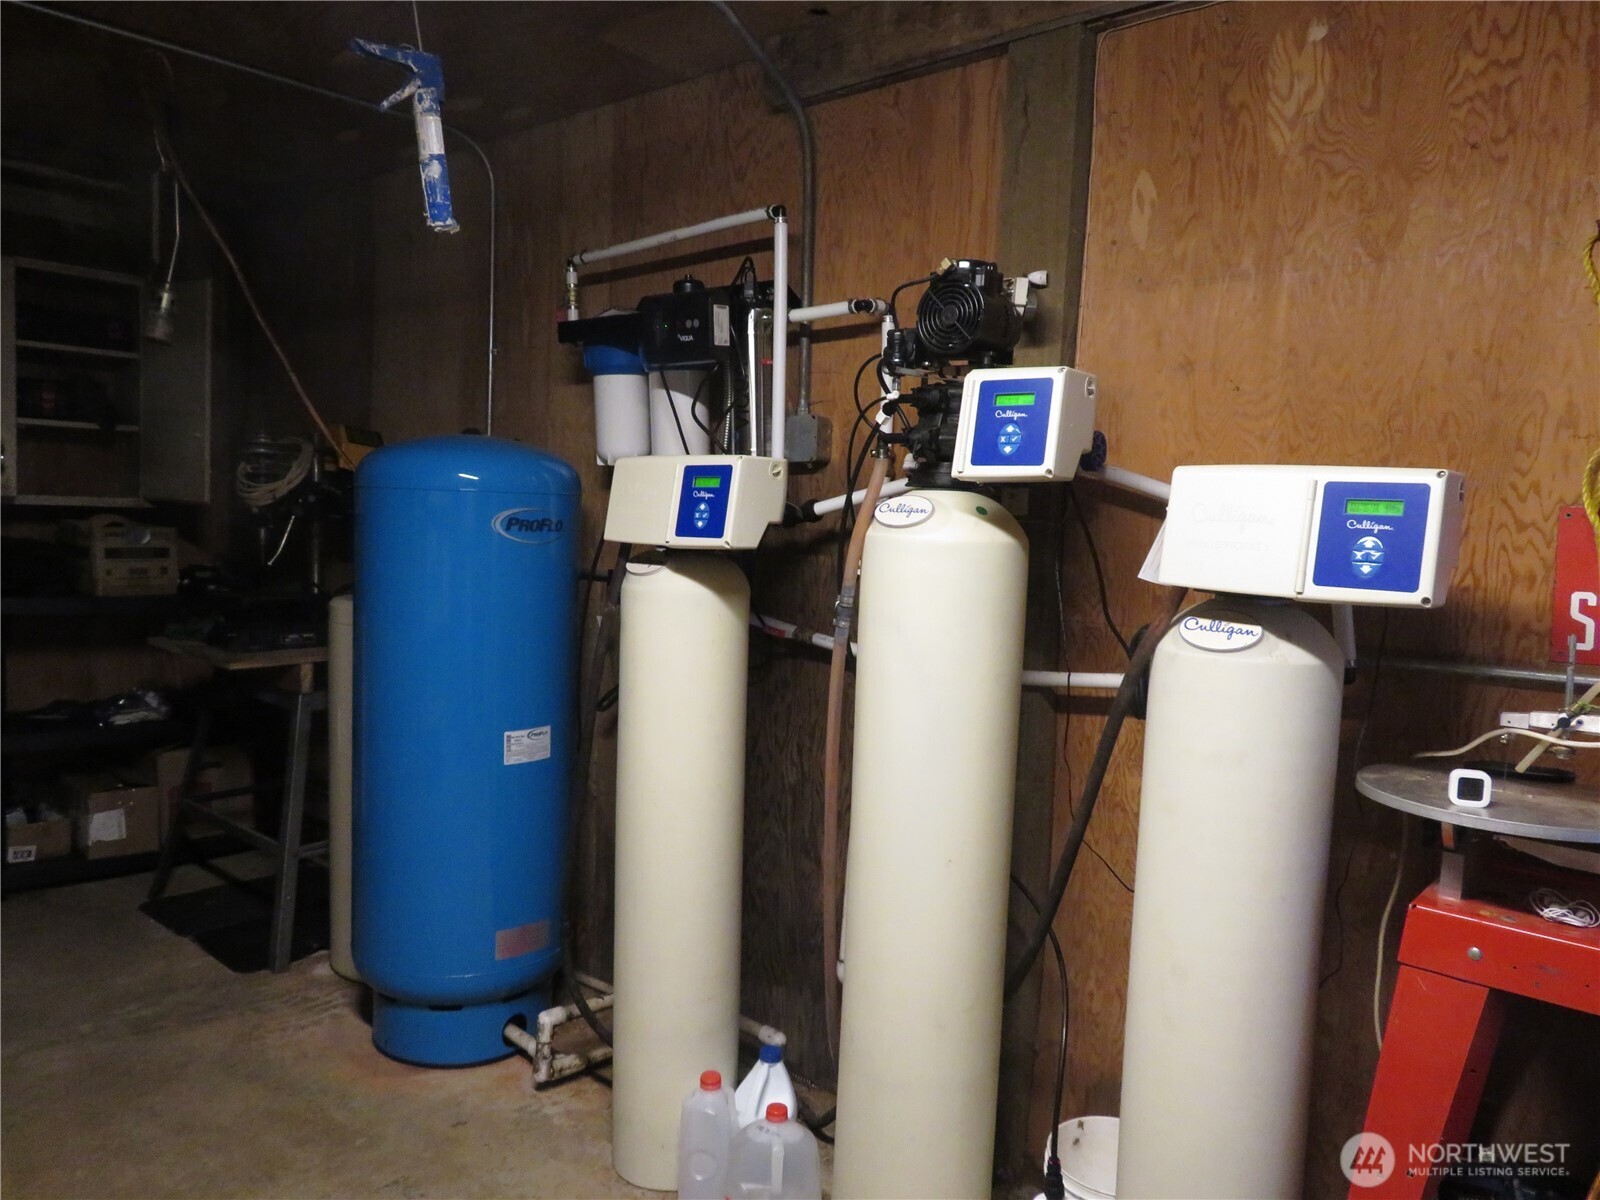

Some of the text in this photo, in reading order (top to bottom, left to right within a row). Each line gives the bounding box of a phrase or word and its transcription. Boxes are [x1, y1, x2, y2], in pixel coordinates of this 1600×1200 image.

[995, 409, 1028, 420] Culligan
[692, 490, 715, 500] Culligan
[879, 502, 928, 518] Culligan
[1346, 519, 1394, 534] Culligan
[1184, 617, 1259, 640] Culligan
